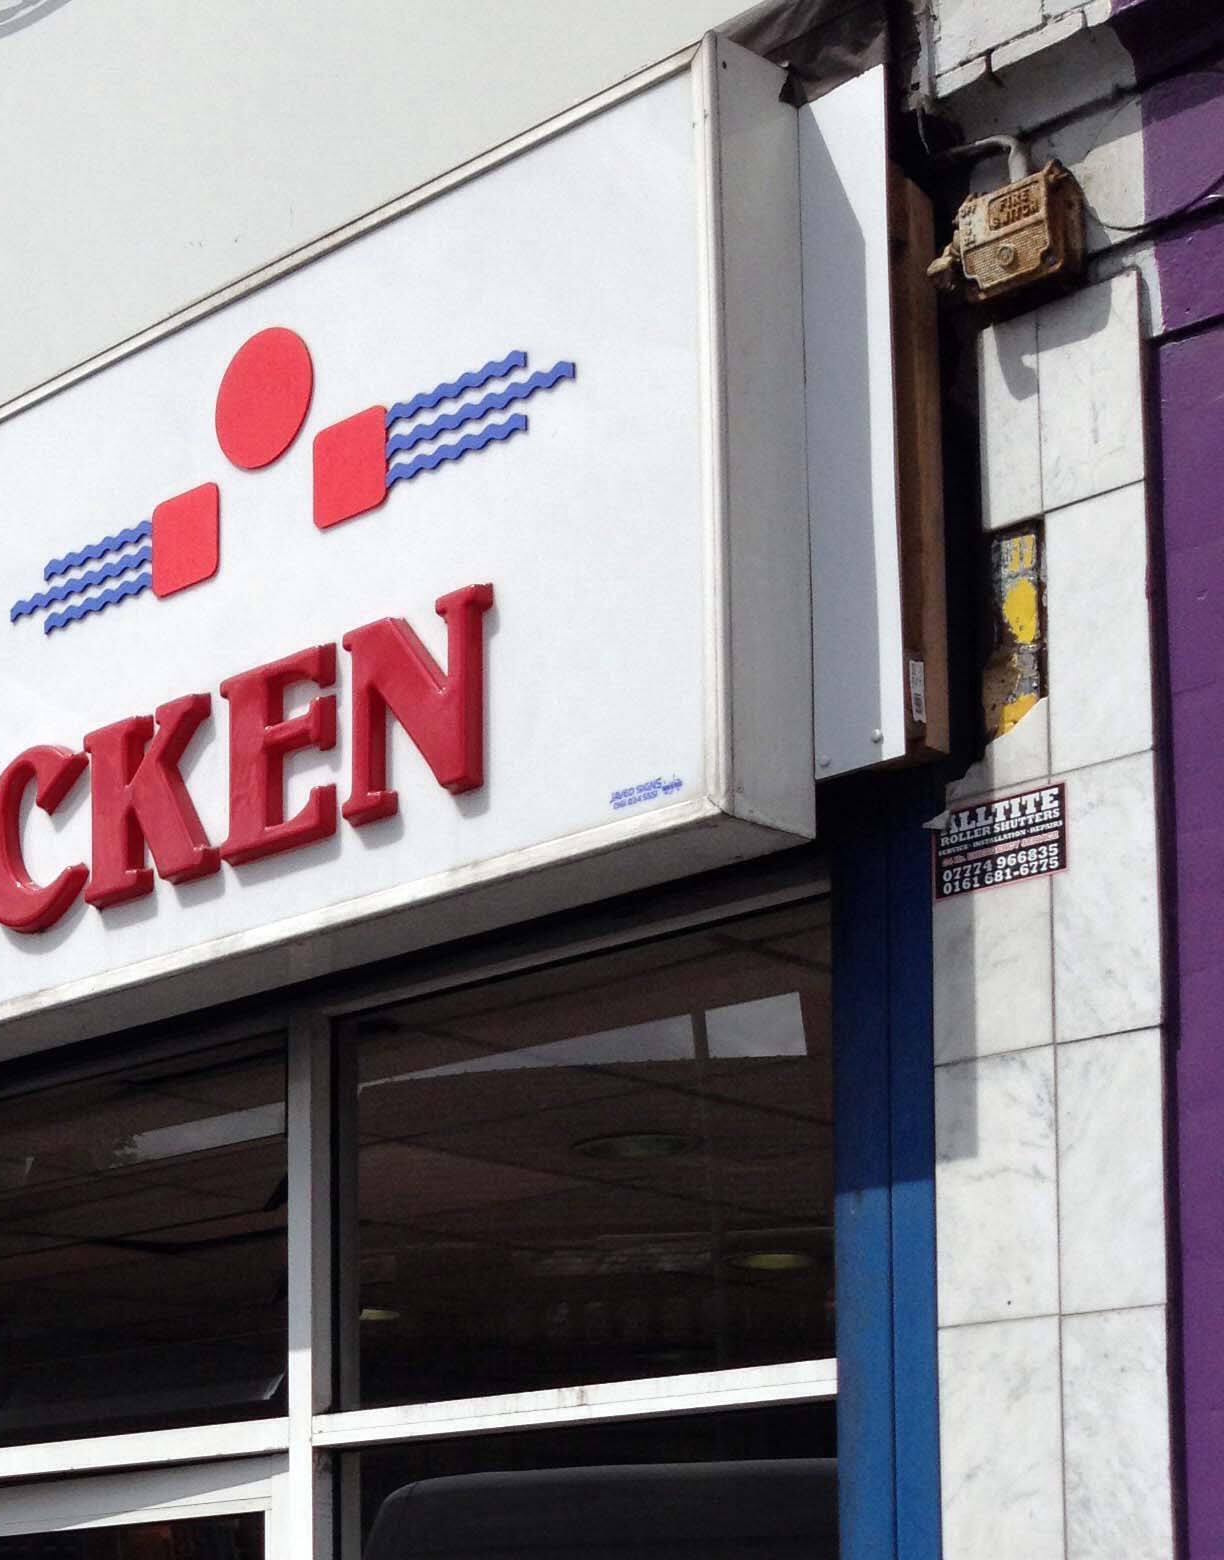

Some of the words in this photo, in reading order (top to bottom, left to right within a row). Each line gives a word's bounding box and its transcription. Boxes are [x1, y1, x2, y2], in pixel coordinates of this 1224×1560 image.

[940, 826, 992, 847] ROLLER
[993, 808, 1060, 833] SHUTTERS
[943, 860, 993, 882] 07774
[996, 843, 1059, 869] 966835
[943, 877, 981, 895] 0161
[984, 856, 1059, 885] 681-6775
